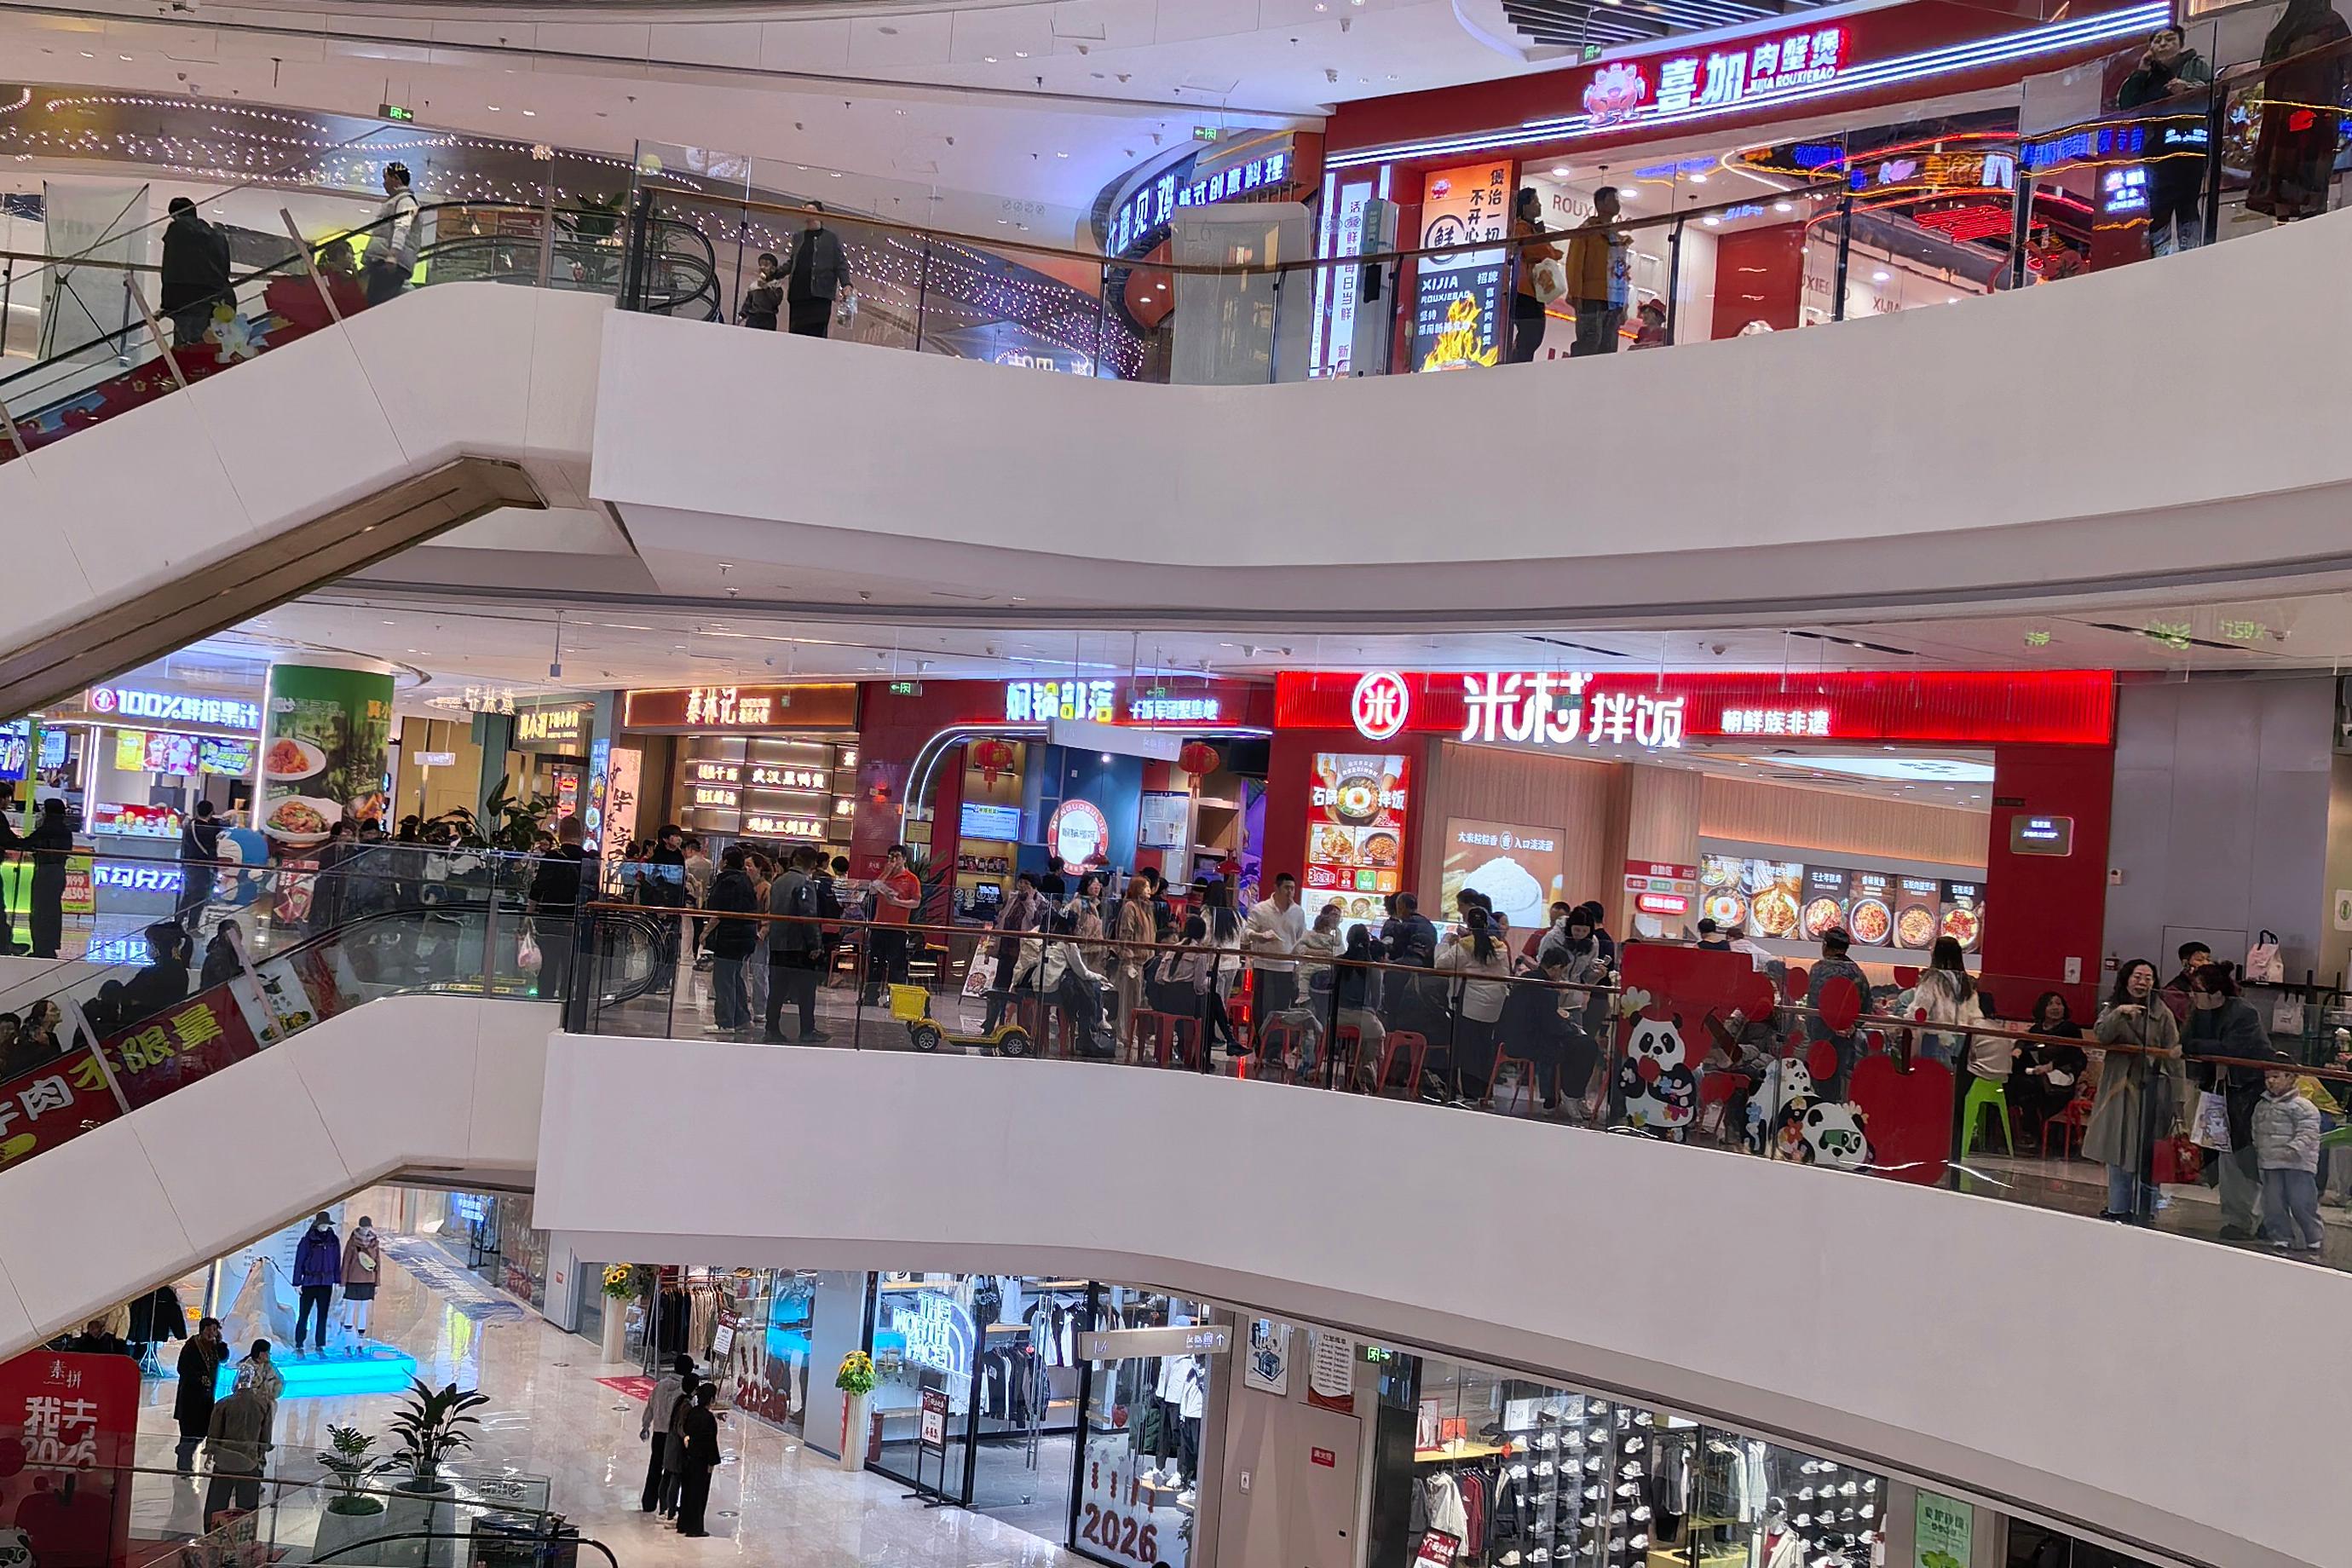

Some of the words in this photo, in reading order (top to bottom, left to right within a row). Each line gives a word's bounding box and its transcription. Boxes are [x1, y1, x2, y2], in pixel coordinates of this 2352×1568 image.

[1657, 53, 1747, 112] 喜加
[1751, 29, 1841, 78] 肉蟹煲
[1776, 66, 1836, 87] ROUXIEBAO
[1421, 275, 1458, 291] XIJIA
[1477, 270, 1499, 285] 招牌
[1421, 290, 1471, 304] ROUXIEBAO
[1461, 672, 1590, 743] 米村
[1588, 693, 1684, 748] 拌饭
[1721, 709, 1830, 736] 朝鲜族非遗
[1313, 786, 1338, 806] 石锅
[1378, 789, 1406, 810] 拌饭
[918, 1290, 952, 1325] THE
[905, 1335, 948, 1372] FACE
[24, 1396, 98, 1440] 我去
[1081, 1502, 1159, 1564] 2026
